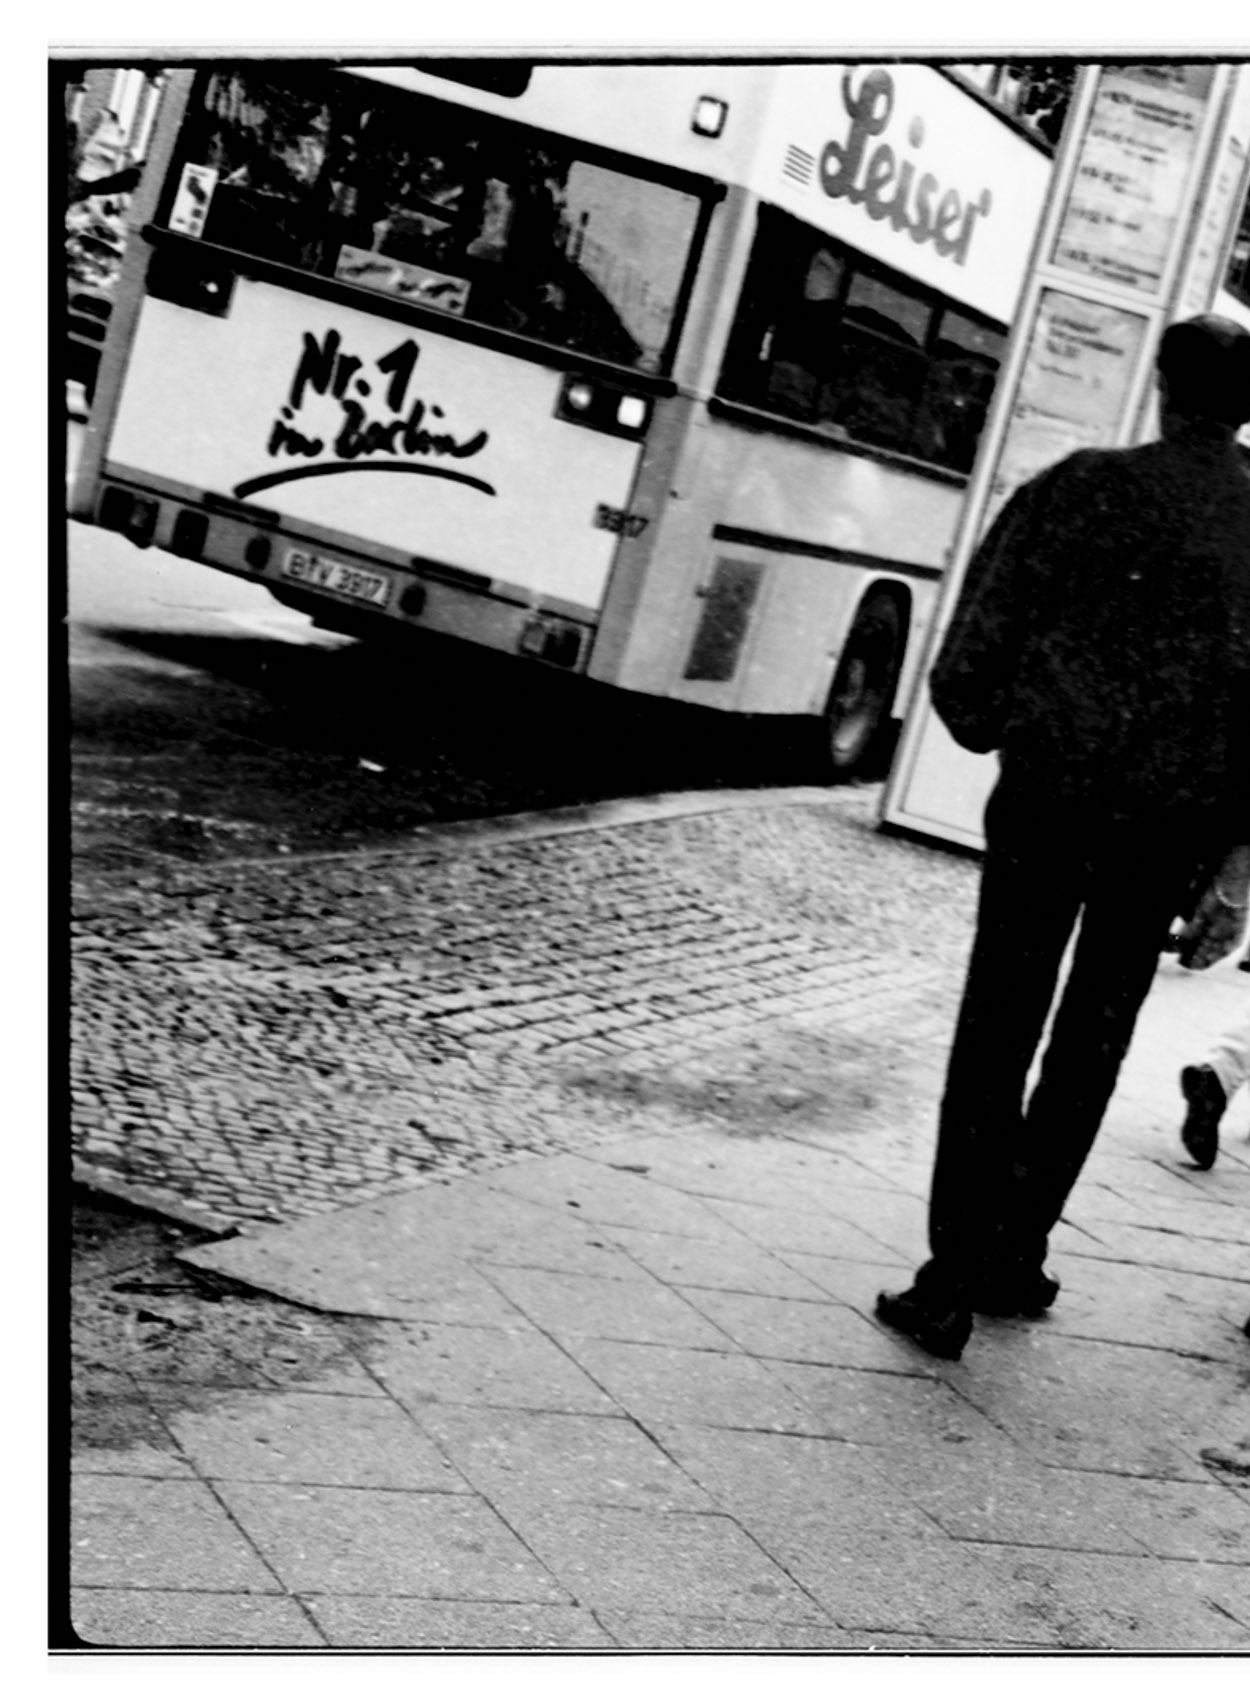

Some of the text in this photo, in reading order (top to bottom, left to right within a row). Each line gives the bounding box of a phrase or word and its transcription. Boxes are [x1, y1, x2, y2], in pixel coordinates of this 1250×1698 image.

[819, 66, 992, 267] Leiser
[289, 327, 420, 414] Nr. 1
[266, 398, 489, 460] in Berlin
